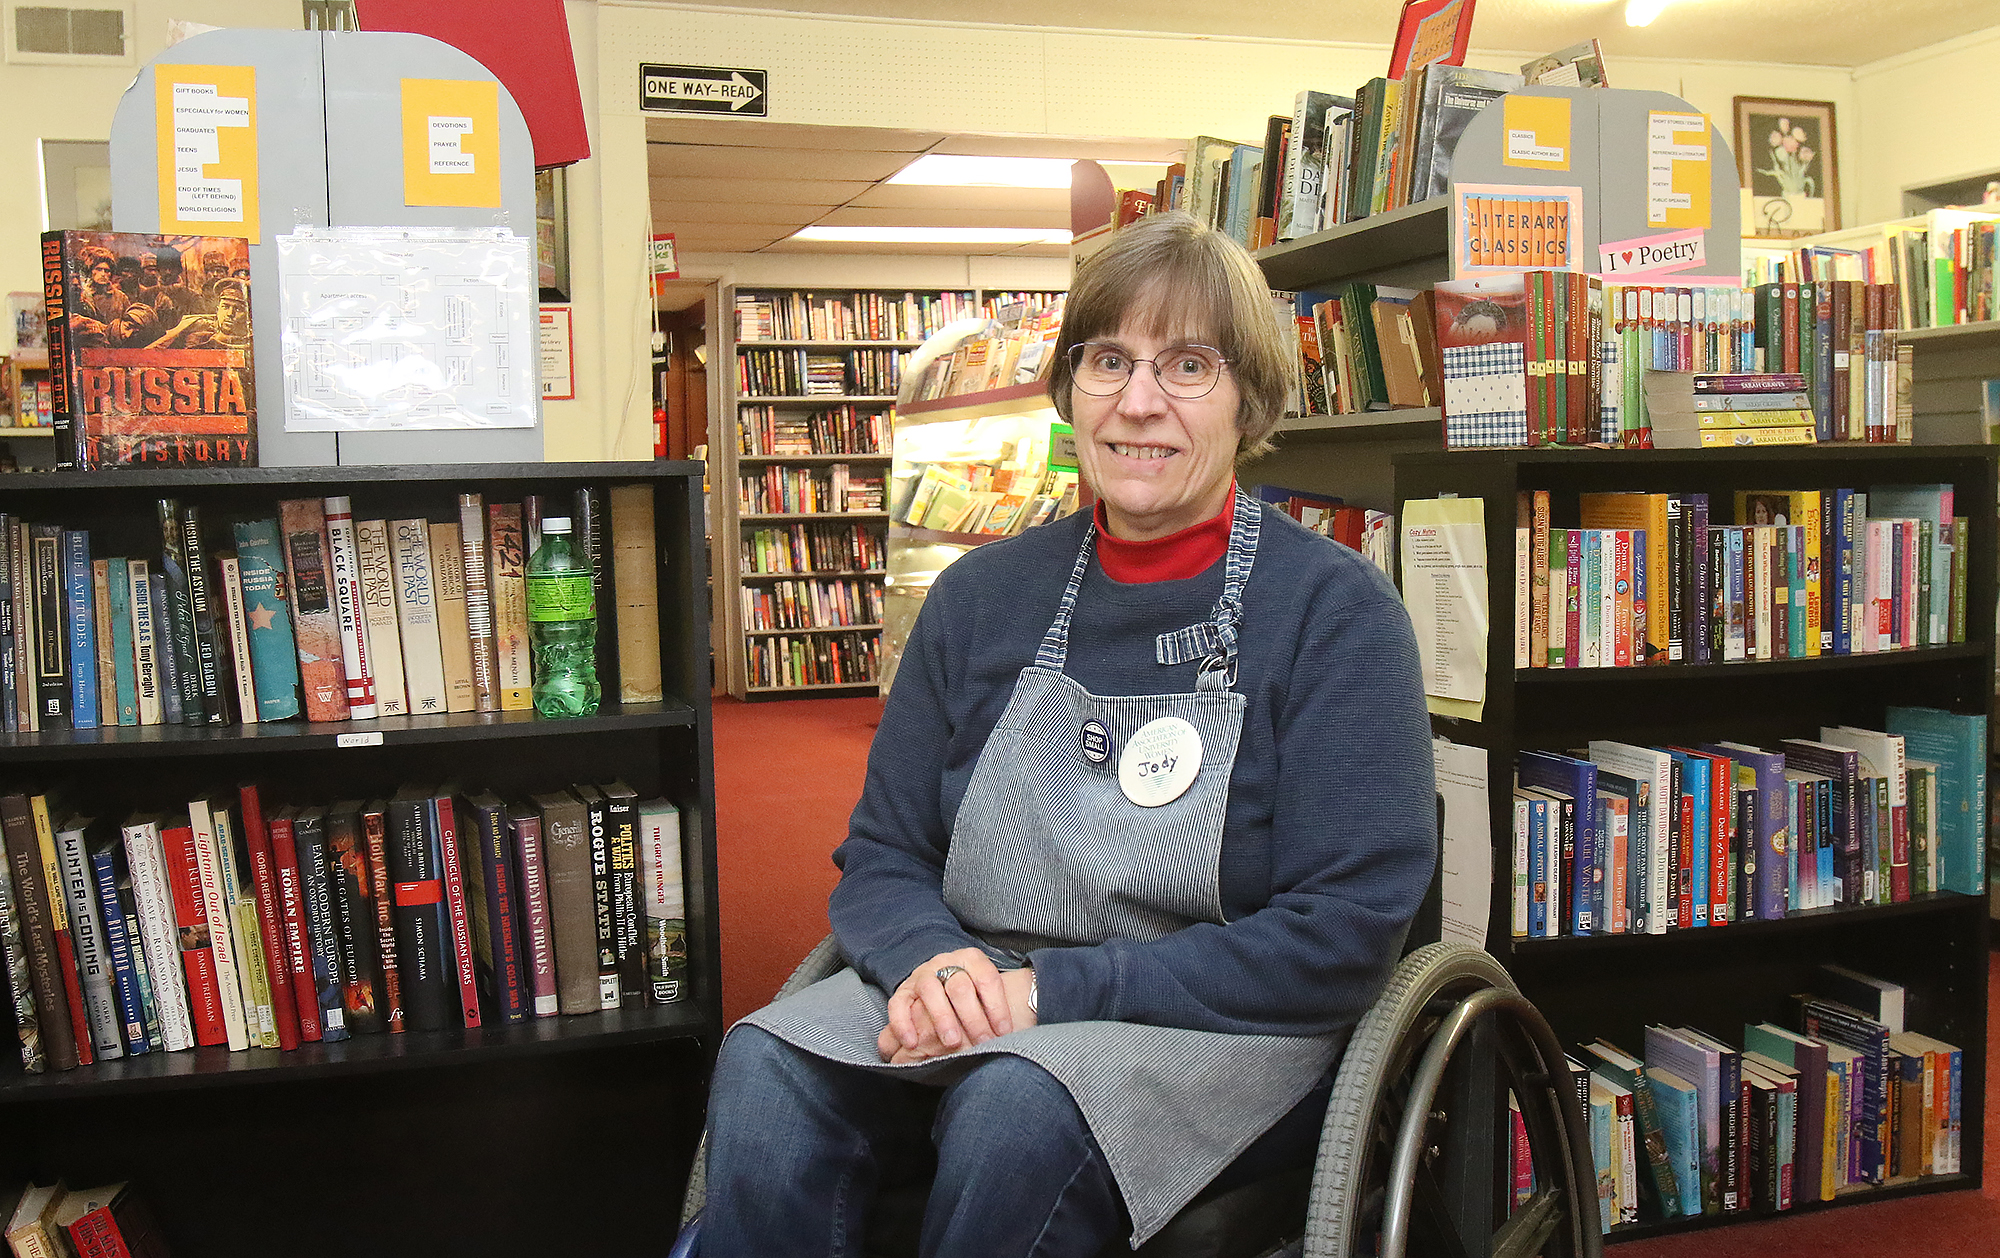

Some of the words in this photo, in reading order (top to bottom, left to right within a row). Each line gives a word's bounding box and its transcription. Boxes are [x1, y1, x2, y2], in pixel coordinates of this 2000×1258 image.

[647, 81, 677, 94] ONE
[1470, 212, 1567, 230] LITERARY
[1470, 238, 1566, 254] CLASSICS
[1608, 253, 1617, 272] I
[1638, 242, 1698, 266] Poetry
[42, 239, 64, 321] RUSSIA
[50, 342, 65, 415] HISTORY
[83, 367, 246, 414] RUSSIA
[86, 440, 99, 462] A
[118, 440, 249, 462] HISTORY
[186, 519, 199, 552] INSIDE
[359, 527, 372, 545] OF
[371, 527, 385, 551] THE
[72, 534, 84, 569] BLUE
[191, 554, 201, 572] THE
[331, 528, 347, 572] BLACK
[362, 550, 375, 575] THE
[498, 525, 522, 580] 1421
[1615, 537, 1623, 577] Andrews
[1621, 542, 1629, 572] Donna
[242, 569, 270, 577] INSIDE
[242, 575, 274, 584] RUSSIA
[374, 554, 392, 608] WORLD
[1656, 561, 1665, 588] Spook
[1699, 563, 1707, 590] Ghost
[135, 580, 149, 606] INSIDE
[192, 575, 206, 612] ASYLUM
[244, 583, 272, 591] TODAY
[365, 578, 379, 608] PAST
[1658, 589, 1664, 599] in
[1699, 592, 1706, 604] on
[74, 573, 87, 648] LATITUDES
[137, 606, 150, 620] THE
[338, 578, 353, 632] SQUARE
[1699, 606, 1707, 622] the
[138, 621, 151, 643] S.A.S.
[1658, 617, 1666, 644] Stacks
[1699, 625, 1707, 646] Case
[138, 644, 152, 662] Tony
[200, 642, 212, 659] JED
[76, 662, 86, 678] Tony
[473, 642, 484, 689] MEDVEDEV
[139, 662, 154, 699] Geraghty
[182, 671, 192, 701] WILSON
[189, 674, 199, 698] DEREK
[203, 662, 217, 697] BABBIN
[77, 680, 87, 709] Horwitz
[1086, 733, 1103, 743] SHOP
[1141, 723, 1178, 739] AMERICAN
[1085, 740, 1104, 752] SMALL
[1897, 741, 1905, 769] JOAN
[1138, 754, 1179, 777] Jody
[1659, 762, 1668, 784] DIANE
[1658, 785, 1668, 806] MOTT
[652, 826, 662, 843] THE
[1658, 807, 1668, 843] DAVIDSON
[183, 838, 197, 865] THE
[590, 811, 606, 876] ROGUE
[610, 836, 620, 845] &
[618, 823, 634, 870] POLITICS
[1582, 828, 1593, 861] CRUEL
[1668, 831, 1679, 872] Untimely
[15, 852, 29, 876] The
[64, 838, 86, 900] WINTER
[197, 831, 215, 889] Lightning
[312, 844, 326, 879] EARLY
[444, 829, 458, 882] CHRONICLE
[611, 846, 622, 870] WAR
[653, 843, 664, 870] GREAT
[335, 862, 344, 883] THE
[1581, 863, 1592, 905] WINTER
[1657, 857, 1666, 893] DOUBLE
[1669, 873, 1677, 899] Death
[21, 877, 39, 924] World's
[188, 867, 205, 918] RETURN
[451, 885, 460, 898] OF
[655, 870, 665, 905] HUNGER
[78, 902, 87, 912] IS
[208, 891, 219, 914] Out
[317, 882, 332, 935] MODERN
[337, 886, 349, 923] GATES
[453, 899, 462, 917] THE
[595, 880, 611, 940] STATE
[1656, 894, 1665, 919] SHOT
[211, 916, 223, 929] of
[280, 868, 296, 917] ROMAN
[288, 921, 305, 974] EMPIRE
[343, 926, 352, 941] OF
[414, 917, 424, 944] SIMON
[29, 925, 44, 951] Last
[78, 914, 100, 976] COMING
[213, 930, 229, 963] Israel
[455, 919, 467, 957] RUSSIAN
[196, 951, 208, 980] DANIEL
[325, 937, 339, 985] EUROPE
[347, 944, 358, 988] EUROPE
[417, 946, 427, 981] SCHAMA
[461, 958, 472, 985] TSARS
[35, 952, 56, 1012] Mysteries
[201, 981, 215, 1022] TREISMAN
[1728, 1100, 1736, 1137] MURDER
[1728, 1139, 1735, 1148] IN
